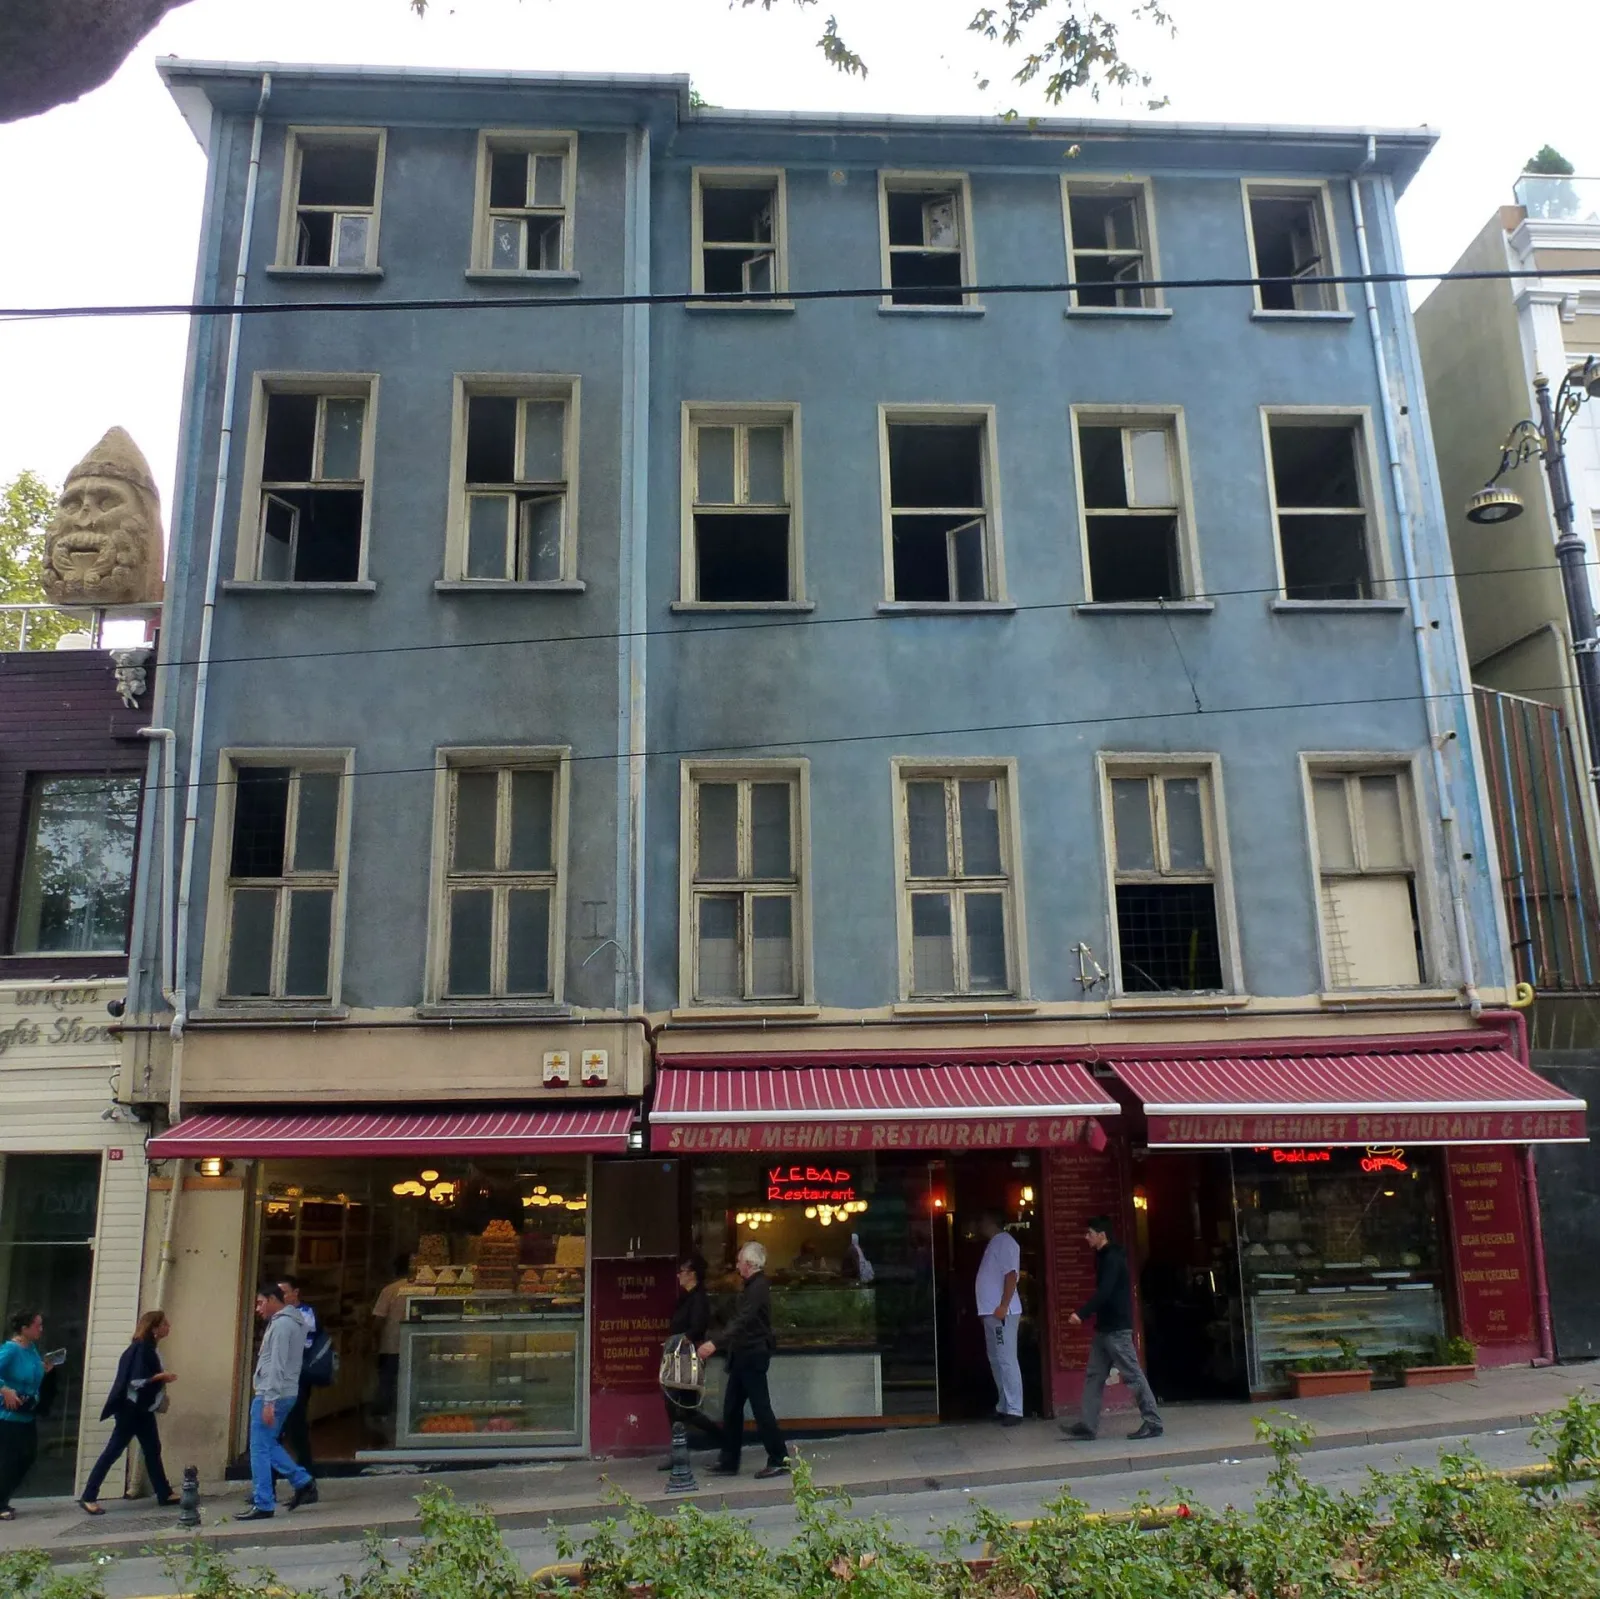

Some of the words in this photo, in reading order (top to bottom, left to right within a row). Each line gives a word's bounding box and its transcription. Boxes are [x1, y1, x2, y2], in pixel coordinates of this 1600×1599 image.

[668, 1126, 751, 1149] SULTAN
[760, 1125, 862, 1148] MEHMET
[871, 1122, 1017, 1147] RESTAURANT
[1025, 1121, 1040, 1143] &
[1167, 1118, 1245, 1141] SULTAN
[1253, 1117, 1348, 1140] MEHMET
[1356, 1115, 1493, 1139] RESTAURANT
[1501, 1116, 1515, 1138] &
[1520, 1115, 1572, 1137] CAFE
[1272, 1149, 1331, 1164] Baklava
[768, 1167, 851, 1185] KEBAP
[767, 1186, 856, 1201] Restaurant
